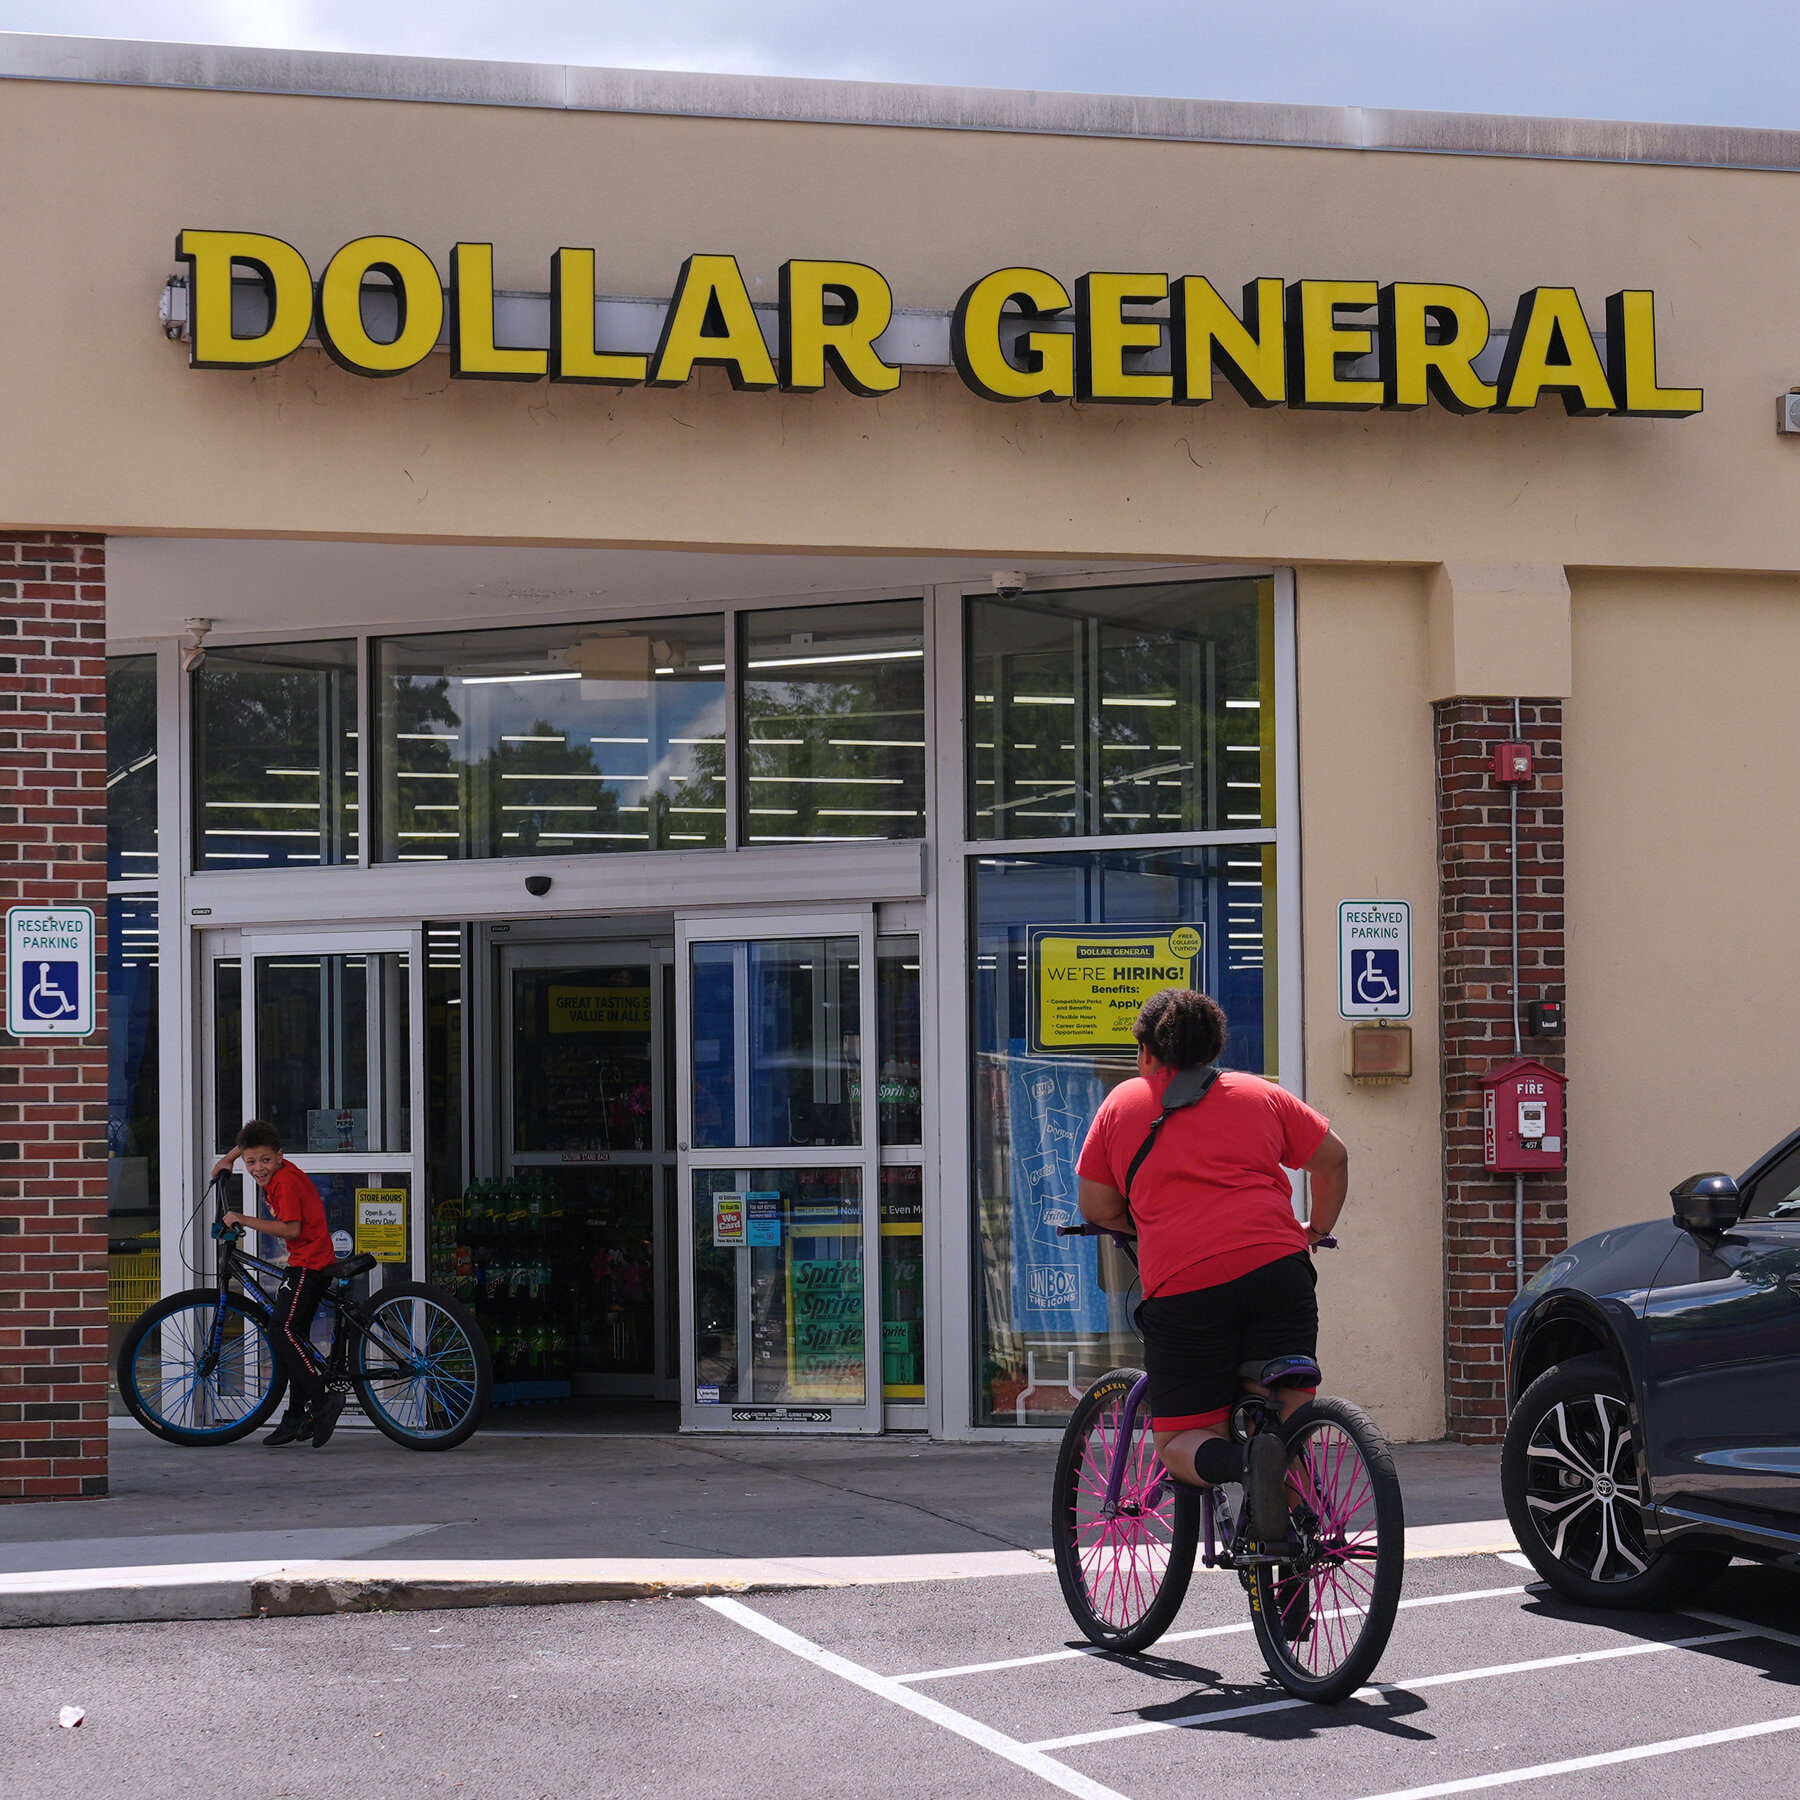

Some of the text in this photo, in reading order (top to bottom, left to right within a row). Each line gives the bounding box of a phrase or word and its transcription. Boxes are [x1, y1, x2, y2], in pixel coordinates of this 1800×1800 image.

[176, 229, 1704, 417] DOLLAR GENERAL
[1346, 912, 1403, 923] RESERVED
[17, 920, 83, 932] RESERVED
[1351, 927, 1398, 939] PARKING
[23, 937, 78, 949] PARKING
[1113, 948, 1150, 956] GENERAL
[1047, 966, 1184, 981] WE'RE HIRING!
[1091, 985, 1140, 994] Benefits:
[556, 997, 593, 1009] GREAT
[595, 997, 640, 1009] TASTING
[1109, 999, 1143, 1009] Apply
[570, 1009, 604, 1022] VALUE
[607, 1009, 618, 1022] IN
[621, 1009, 641, 1022] ALL
[1516, 1083, 1544, 1095] FIRE
[1046, 1124, 1074, 1140] Doritos
[1485, 1092, 1495, 1162] FIRE
[1525, 1141, 1538, 1149] 457
[360, 1193, 402, 1202] STORE HOURS
[888, 1206, 911, 1215] Even
[1043, 1209, 1070, 1224] Fritos
[365, 1218, 382, 1226] Every
[722, 1213, 737, 1222] We
[719, 1221, 741, 1230] Card
[796, 1261, 862, 1289] Sprite
[1029, 1266, 1076, 1299] UNBOX
[800, 1290, 861, 1320] Sprite
[1029, 1293, 1076, 1308] THE ICONS
[801, 1322, 863, 1351] Sprite
[802, 1354, 863, 1378] Sprite
[1093, 1382, 1127, 1400] MAXXIS
[1249, 1541, 1262, 1612] MAXXS
